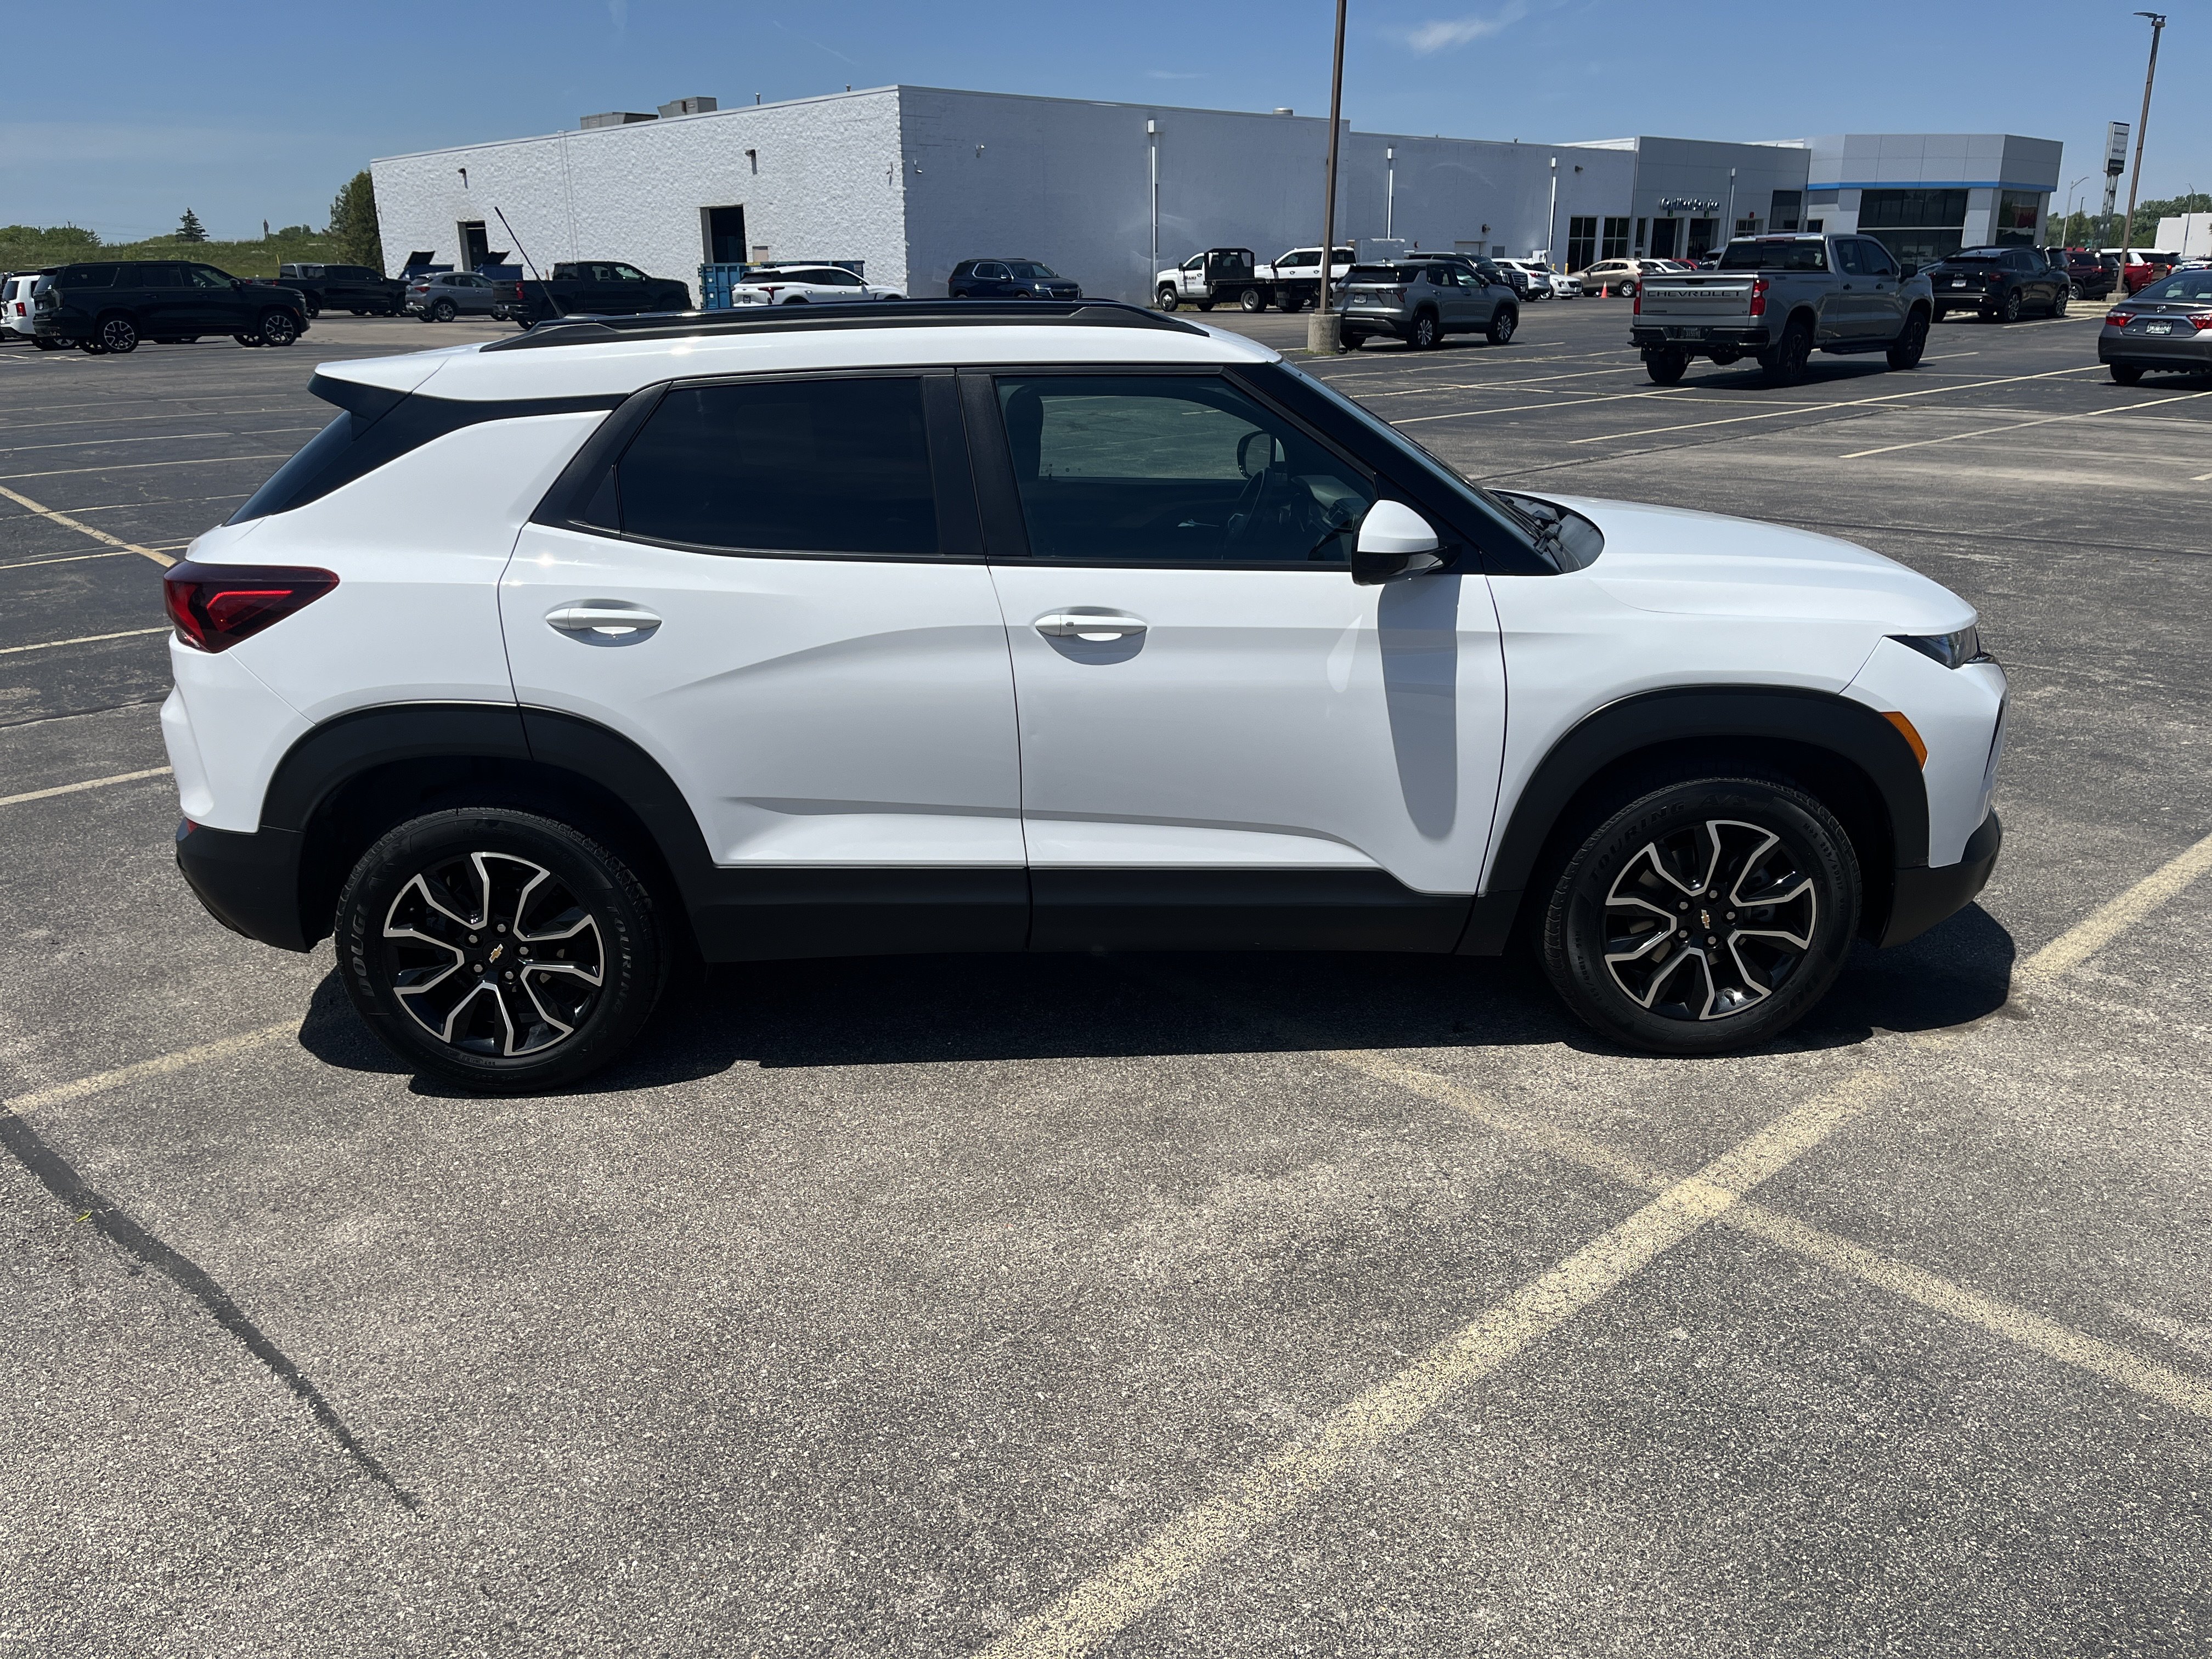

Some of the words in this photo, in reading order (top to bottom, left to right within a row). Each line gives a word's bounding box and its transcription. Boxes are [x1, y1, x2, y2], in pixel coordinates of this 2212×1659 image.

[1660, 198, 1692, 211] Certified
[1693, 199, 1720, 211] Service
[1591, 801, 1684, 881] TOURING
[1700, 794, 1747, 807] A/S
[606, 903, 633, 1015] TOURING
